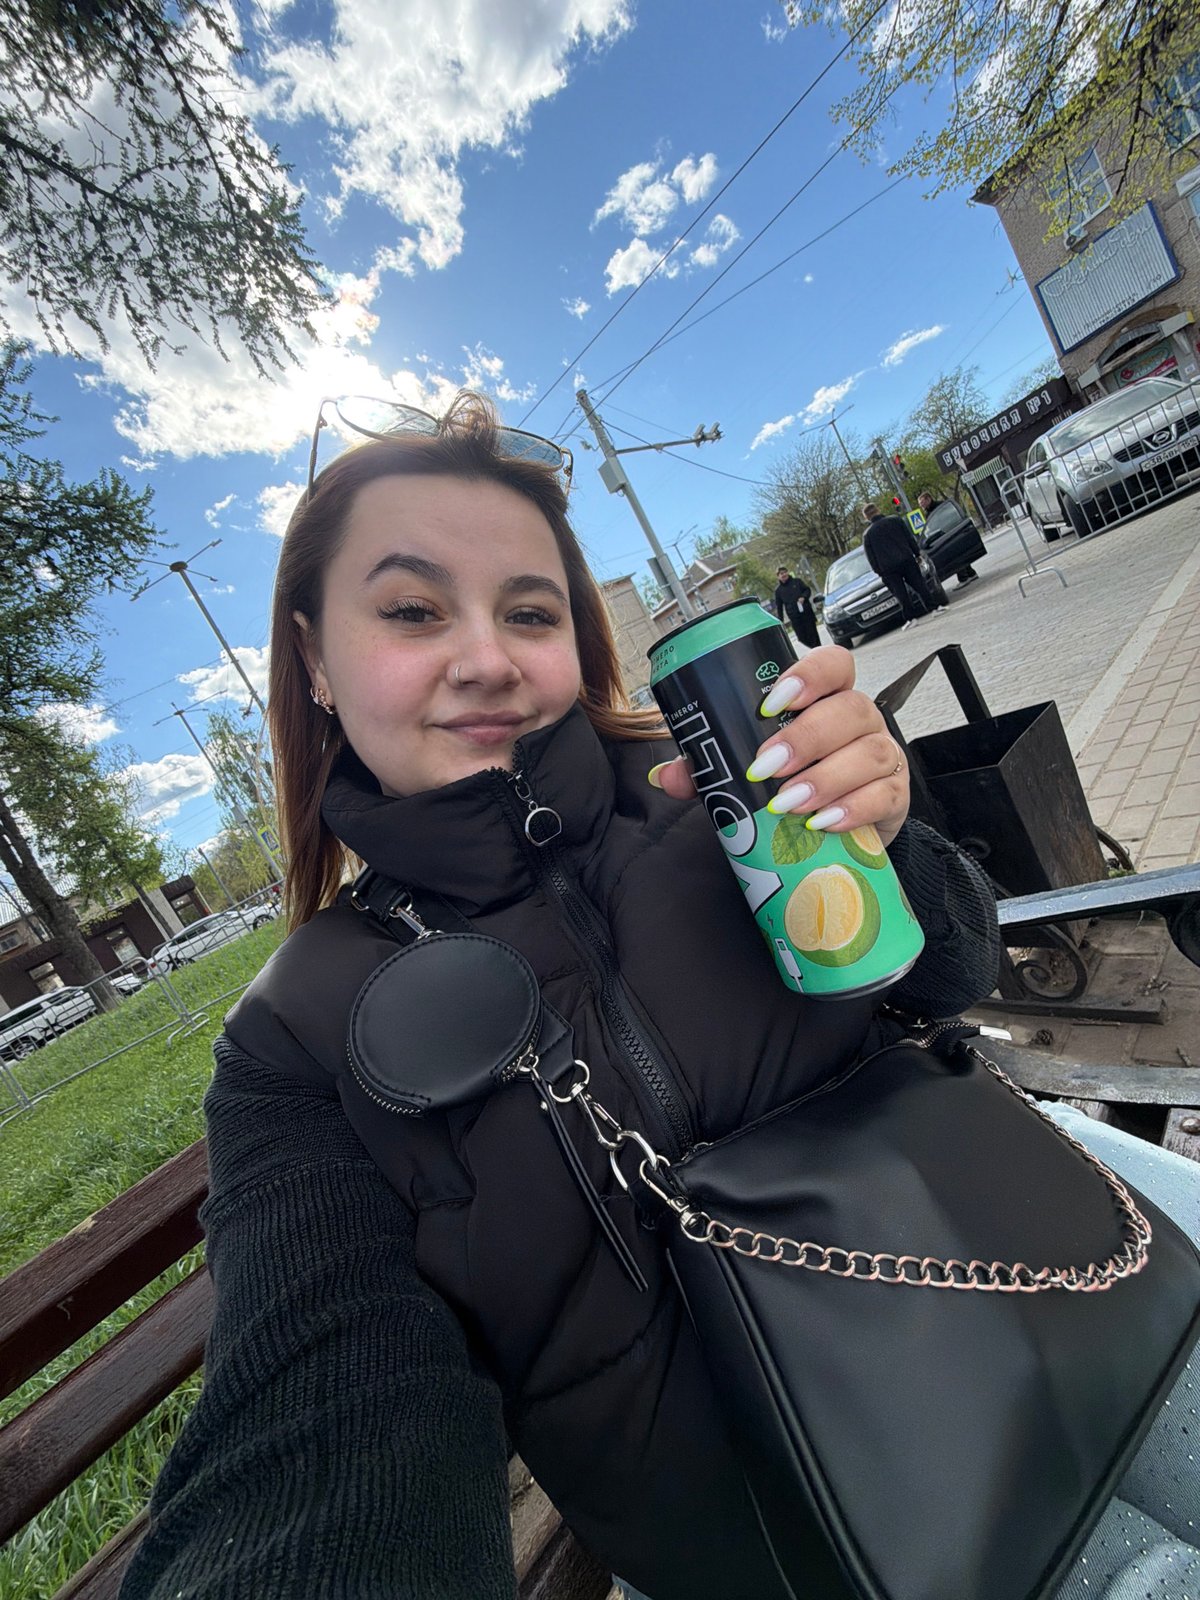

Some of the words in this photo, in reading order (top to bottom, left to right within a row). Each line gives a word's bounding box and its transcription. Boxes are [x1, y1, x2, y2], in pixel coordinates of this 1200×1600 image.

[942, 409, 1021, 467] БУЛОЧНАЯ
[761, 683, 774, 694] КО
[670, 700, 699, 721] ENERGY
[664, 711, 785, 917] VOLT
